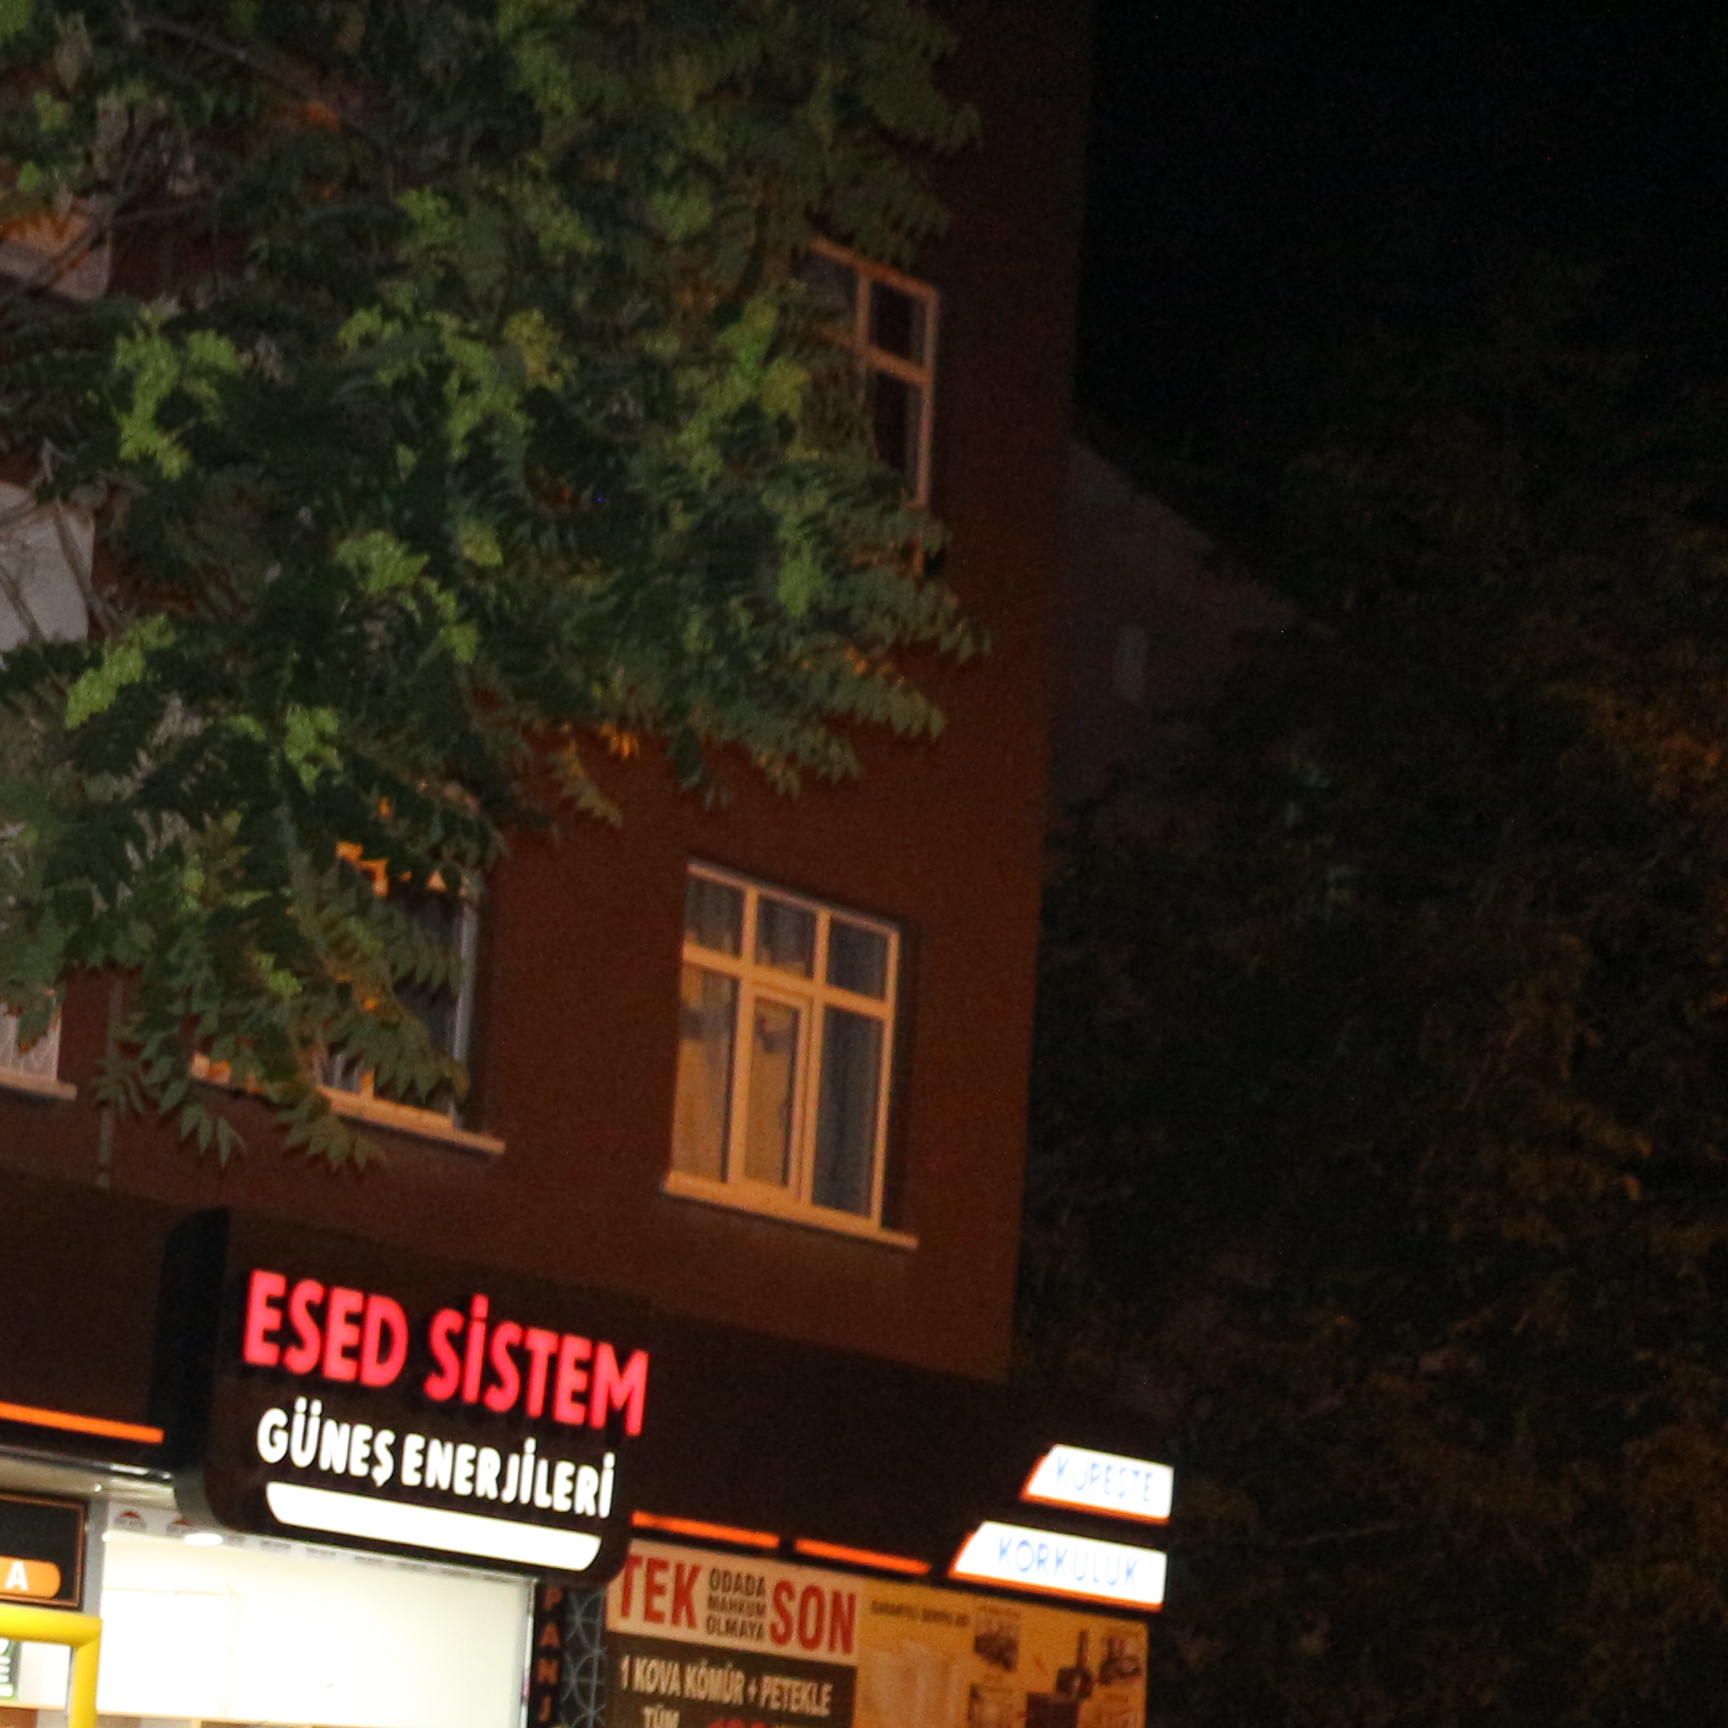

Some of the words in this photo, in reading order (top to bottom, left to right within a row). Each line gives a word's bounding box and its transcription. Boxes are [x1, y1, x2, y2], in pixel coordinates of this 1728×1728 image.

[242, 1268, 409, 1388] ESED
[256, 1395, 395, 1487] GÜNEŞ
[401, 1433, 616, 1519] ENERJİLERİ
[618, 1554, 703, 1630] TEK
[709, 1567, 767, 1597] ODADA
[997, 1535, 1140, 1589] KORKULUK
[769, 1579, 858, 1656] SON
